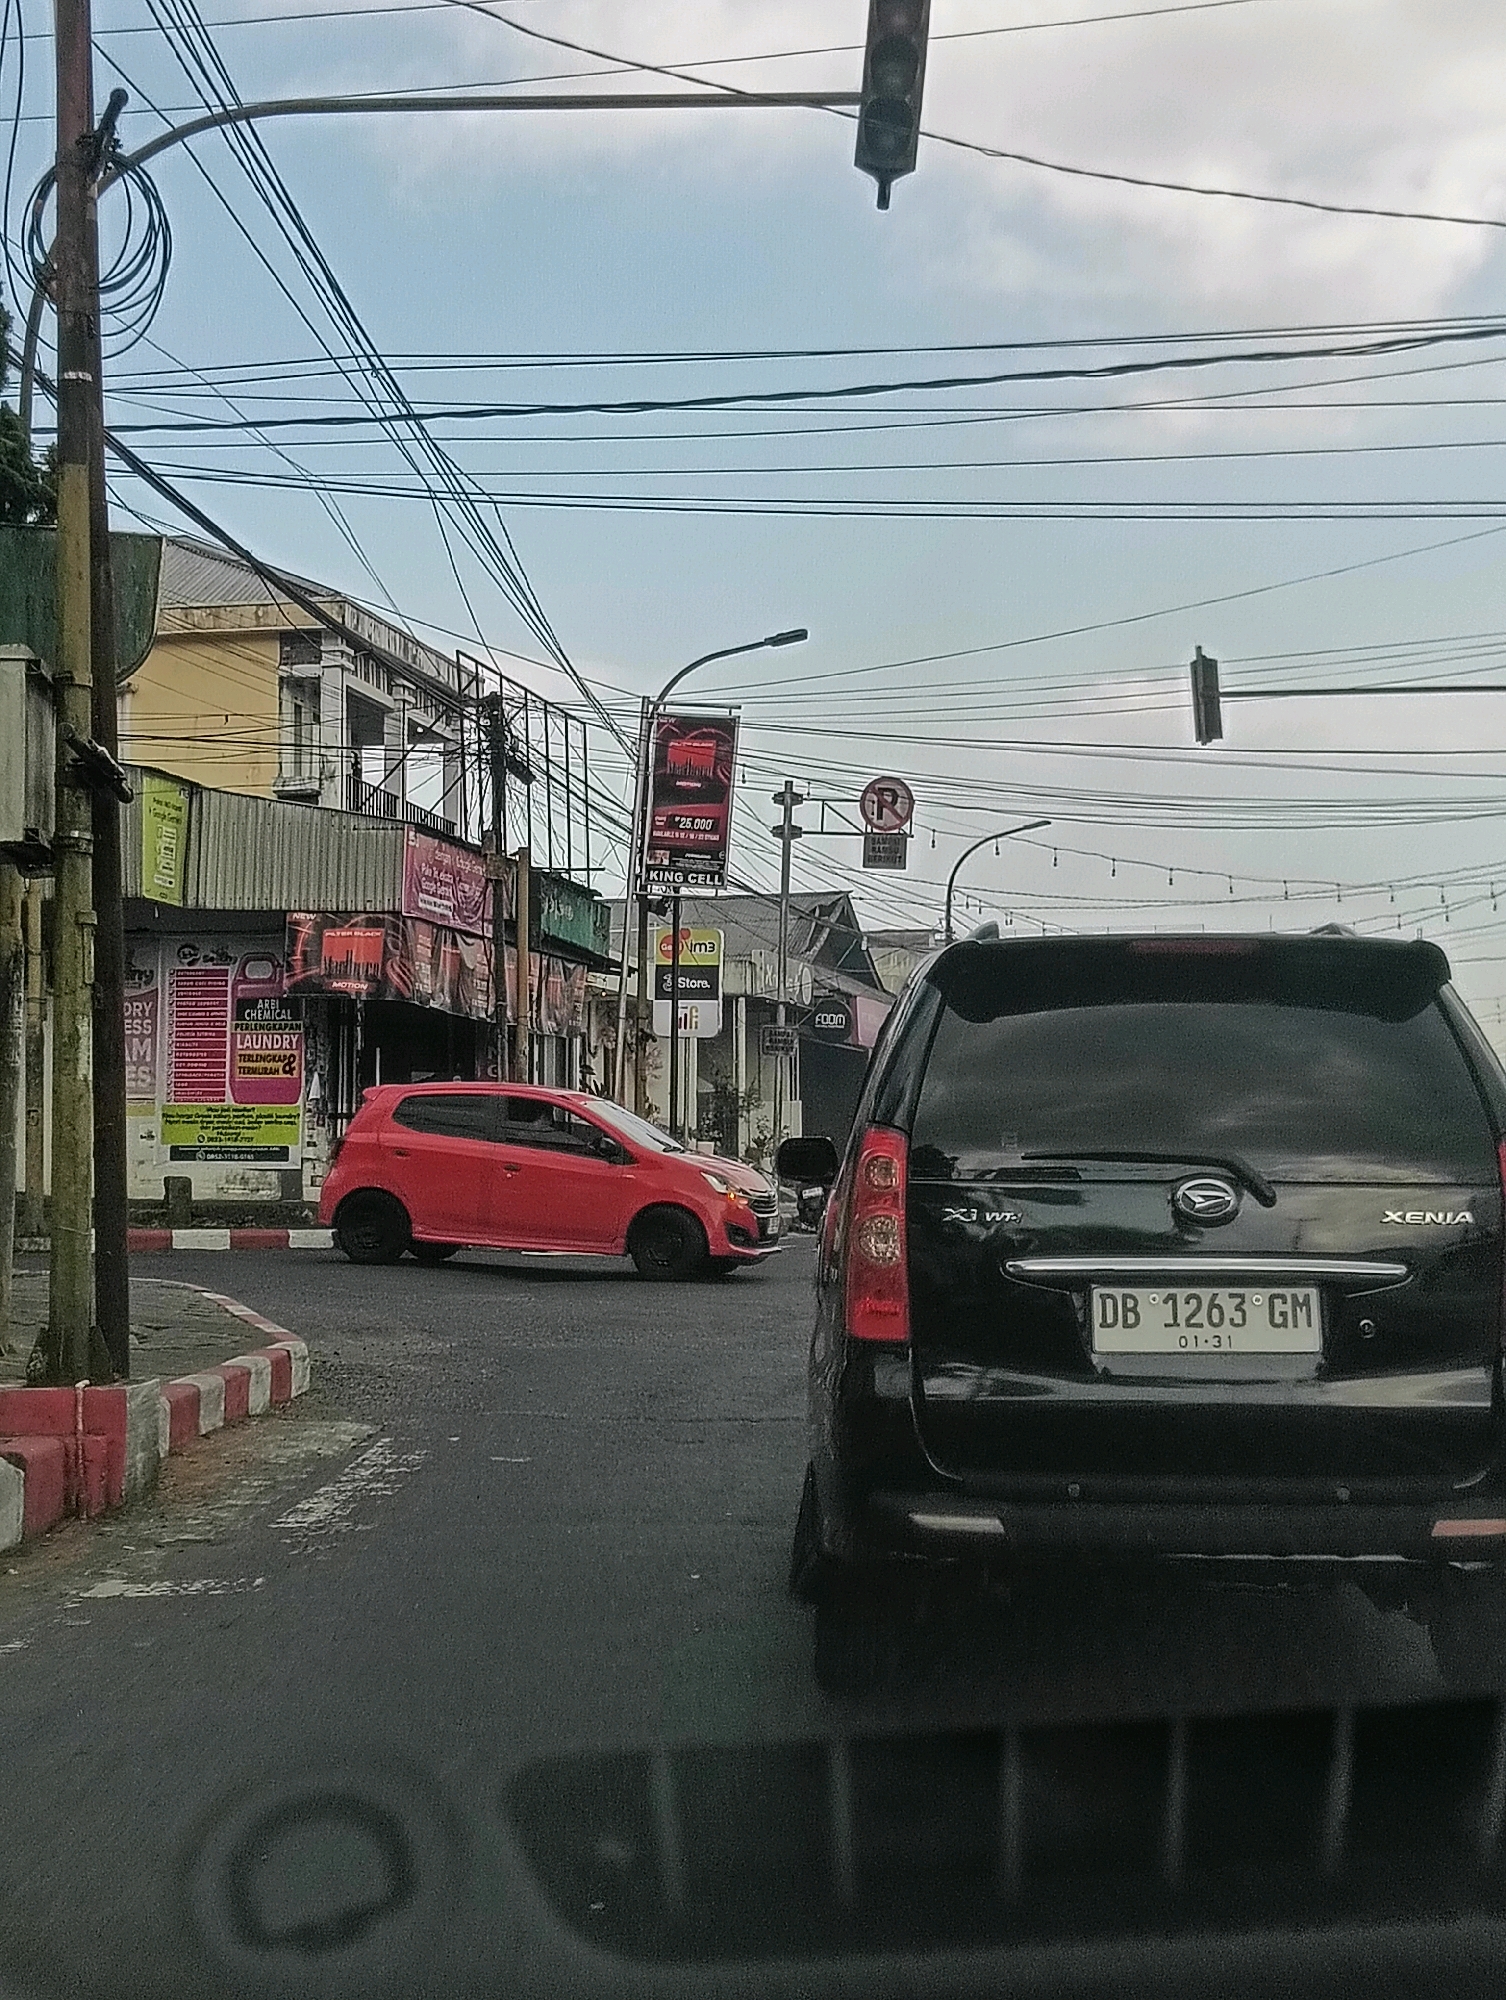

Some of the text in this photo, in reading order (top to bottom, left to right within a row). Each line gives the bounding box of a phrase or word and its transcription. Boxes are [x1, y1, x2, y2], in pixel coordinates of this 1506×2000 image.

[649, 870, 722, 886] KING CELL
[292, 912, 317, 920] NEW
[332, 981, 369, 990] MOTION
[257, 999, 280, 1010] ARBI
[244, 1009, 293, 1021] CHEMICAL
[234, 1022, 302, 1032] PERLENGKAPAN
[236, 1034, 300, 1050] LAUNDRY
[237, 1053, 288, 1063] TERLENGKAP
[237, 1065, 280, 1076] TERMURAH
[1380, 1210, 1475, 1225] XENIA
[1099, 1292, 1313, 1330] DB 1263 GM
